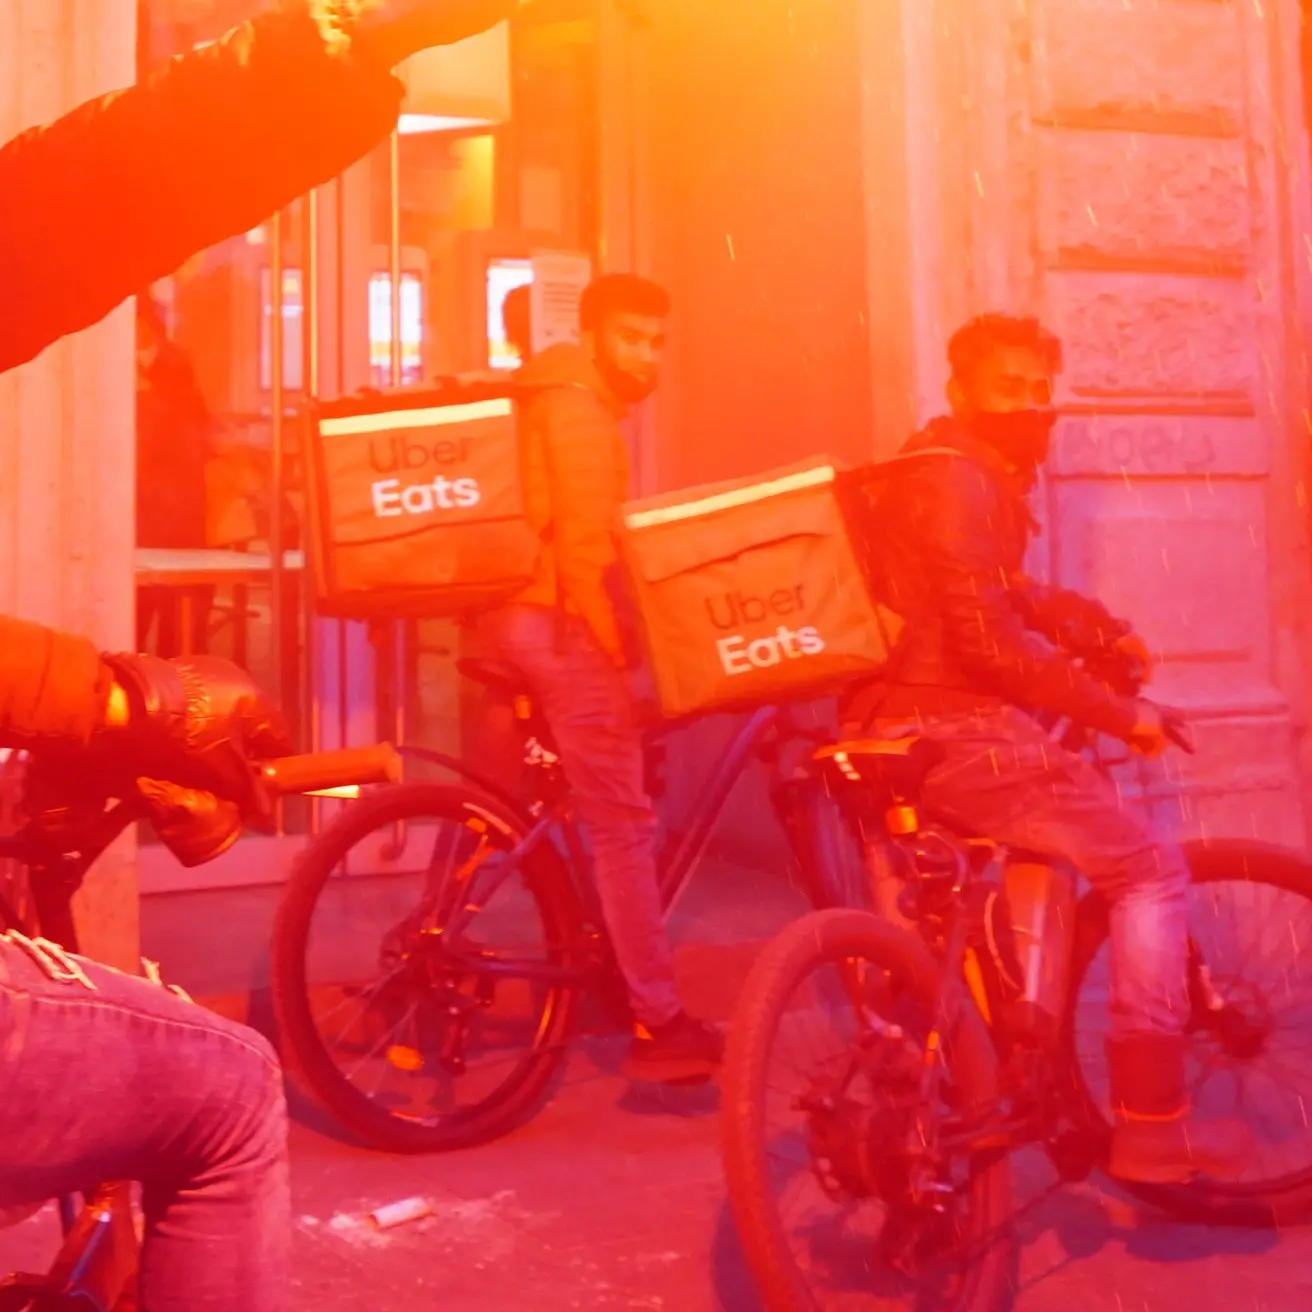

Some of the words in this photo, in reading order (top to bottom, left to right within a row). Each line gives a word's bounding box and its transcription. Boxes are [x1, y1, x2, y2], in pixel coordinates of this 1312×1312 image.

[368, 435, 474, 474] Uber
[371, 474, 480, 517] Eats
[704, 583, 805, 630] Uber
[716, 625, 826, 676] Eats
